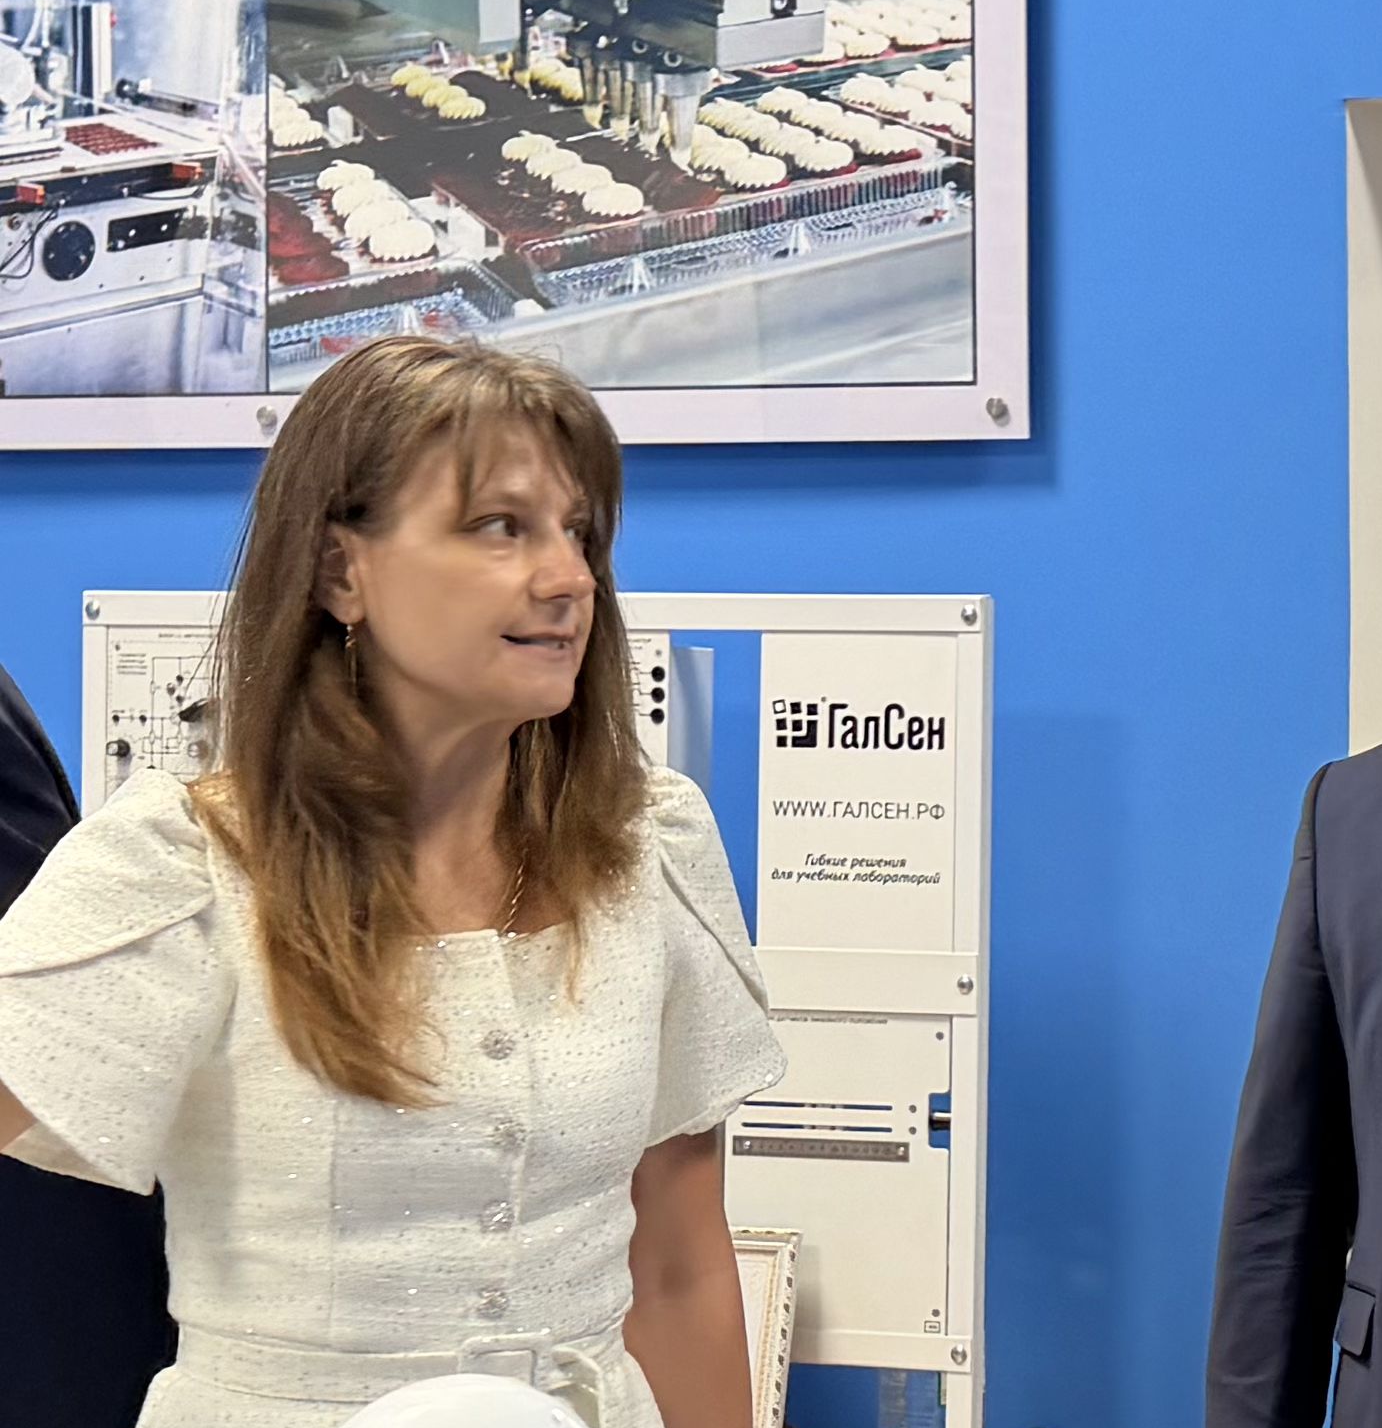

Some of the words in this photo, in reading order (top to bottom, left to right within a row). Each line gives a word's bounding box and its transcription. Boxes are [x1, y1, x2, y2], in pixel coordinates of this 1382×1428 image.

[828, 703, 945, 750] ГалСен
[773, 801, 945, 820] WWW.ГАЛСЕН.РФ
[804, 853, 847, 867] Гибкие
[850, 857, 906, 870] решения
[771, 868, 793, 880] для
[796, 869, 849, 883] учебных
[852, 871, 940, 886] лабораторий
